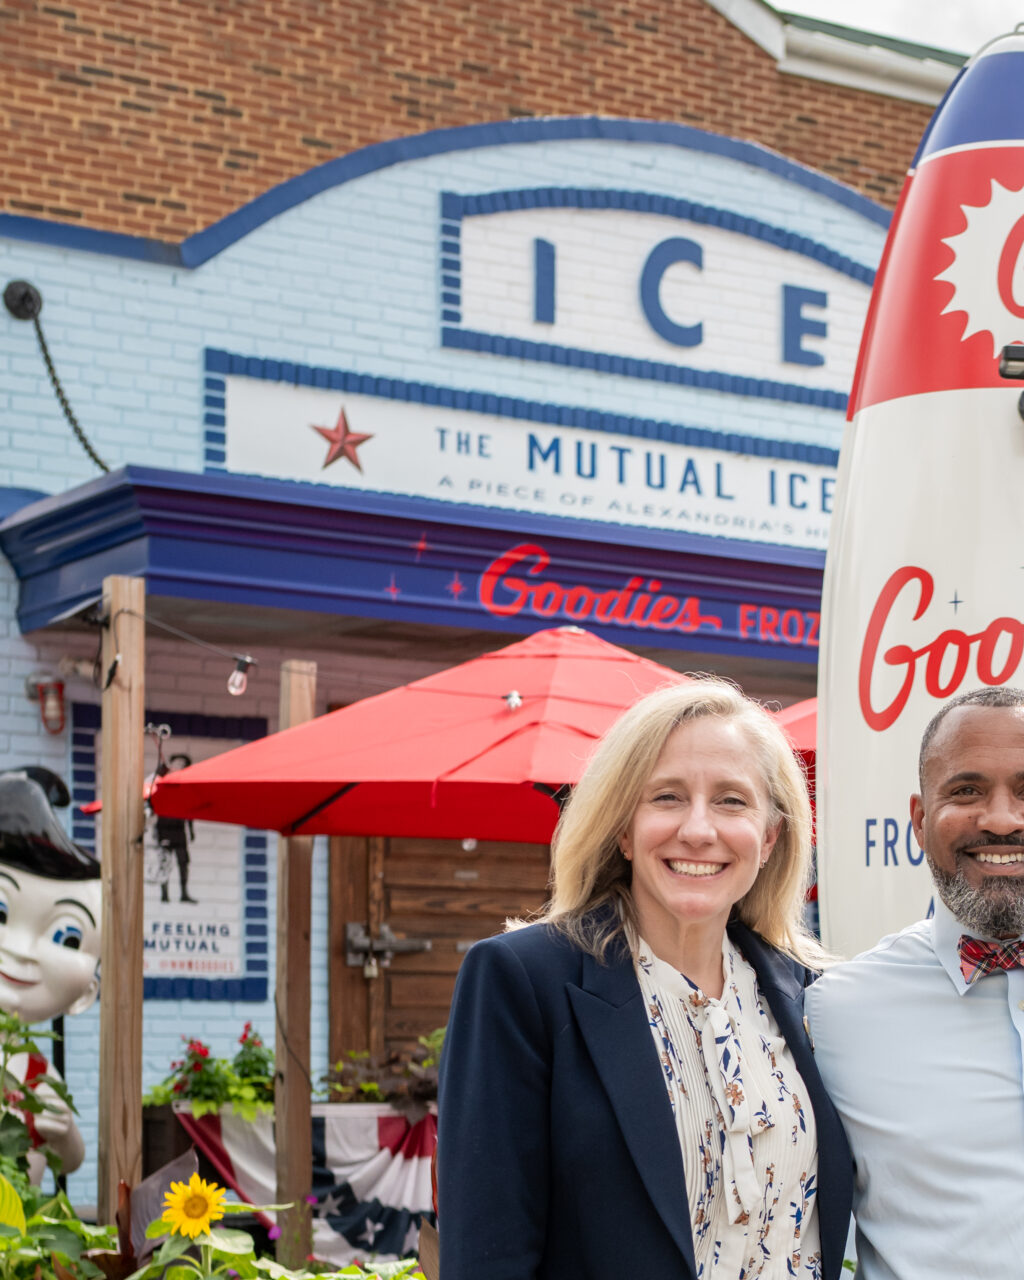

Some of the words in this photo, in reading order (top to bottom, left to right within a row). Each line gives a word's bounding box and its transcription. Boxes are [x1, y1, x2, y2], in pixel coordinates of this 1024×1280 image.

[534, 237, 828, 367] ICE
[436, 427, 492, 459] THE
[528, 432, 735, 501] MUTUAL
[770, 469, 837, 514] ICE
[438, 475, 453, 488] A
[468, 478, 545, 501] PIECE
[559, 492, 593, 506] OF
[607, 499, 794, 536] ALEXANDRIA'S
[479, 543, 722, 633] Goodies
[738, 603, 820, 647] FROZ
[865, 817, 925, 867] FRO
[143, 939, 220, 953] MUTUAL
[152, 922, 230, 937] FEELING
